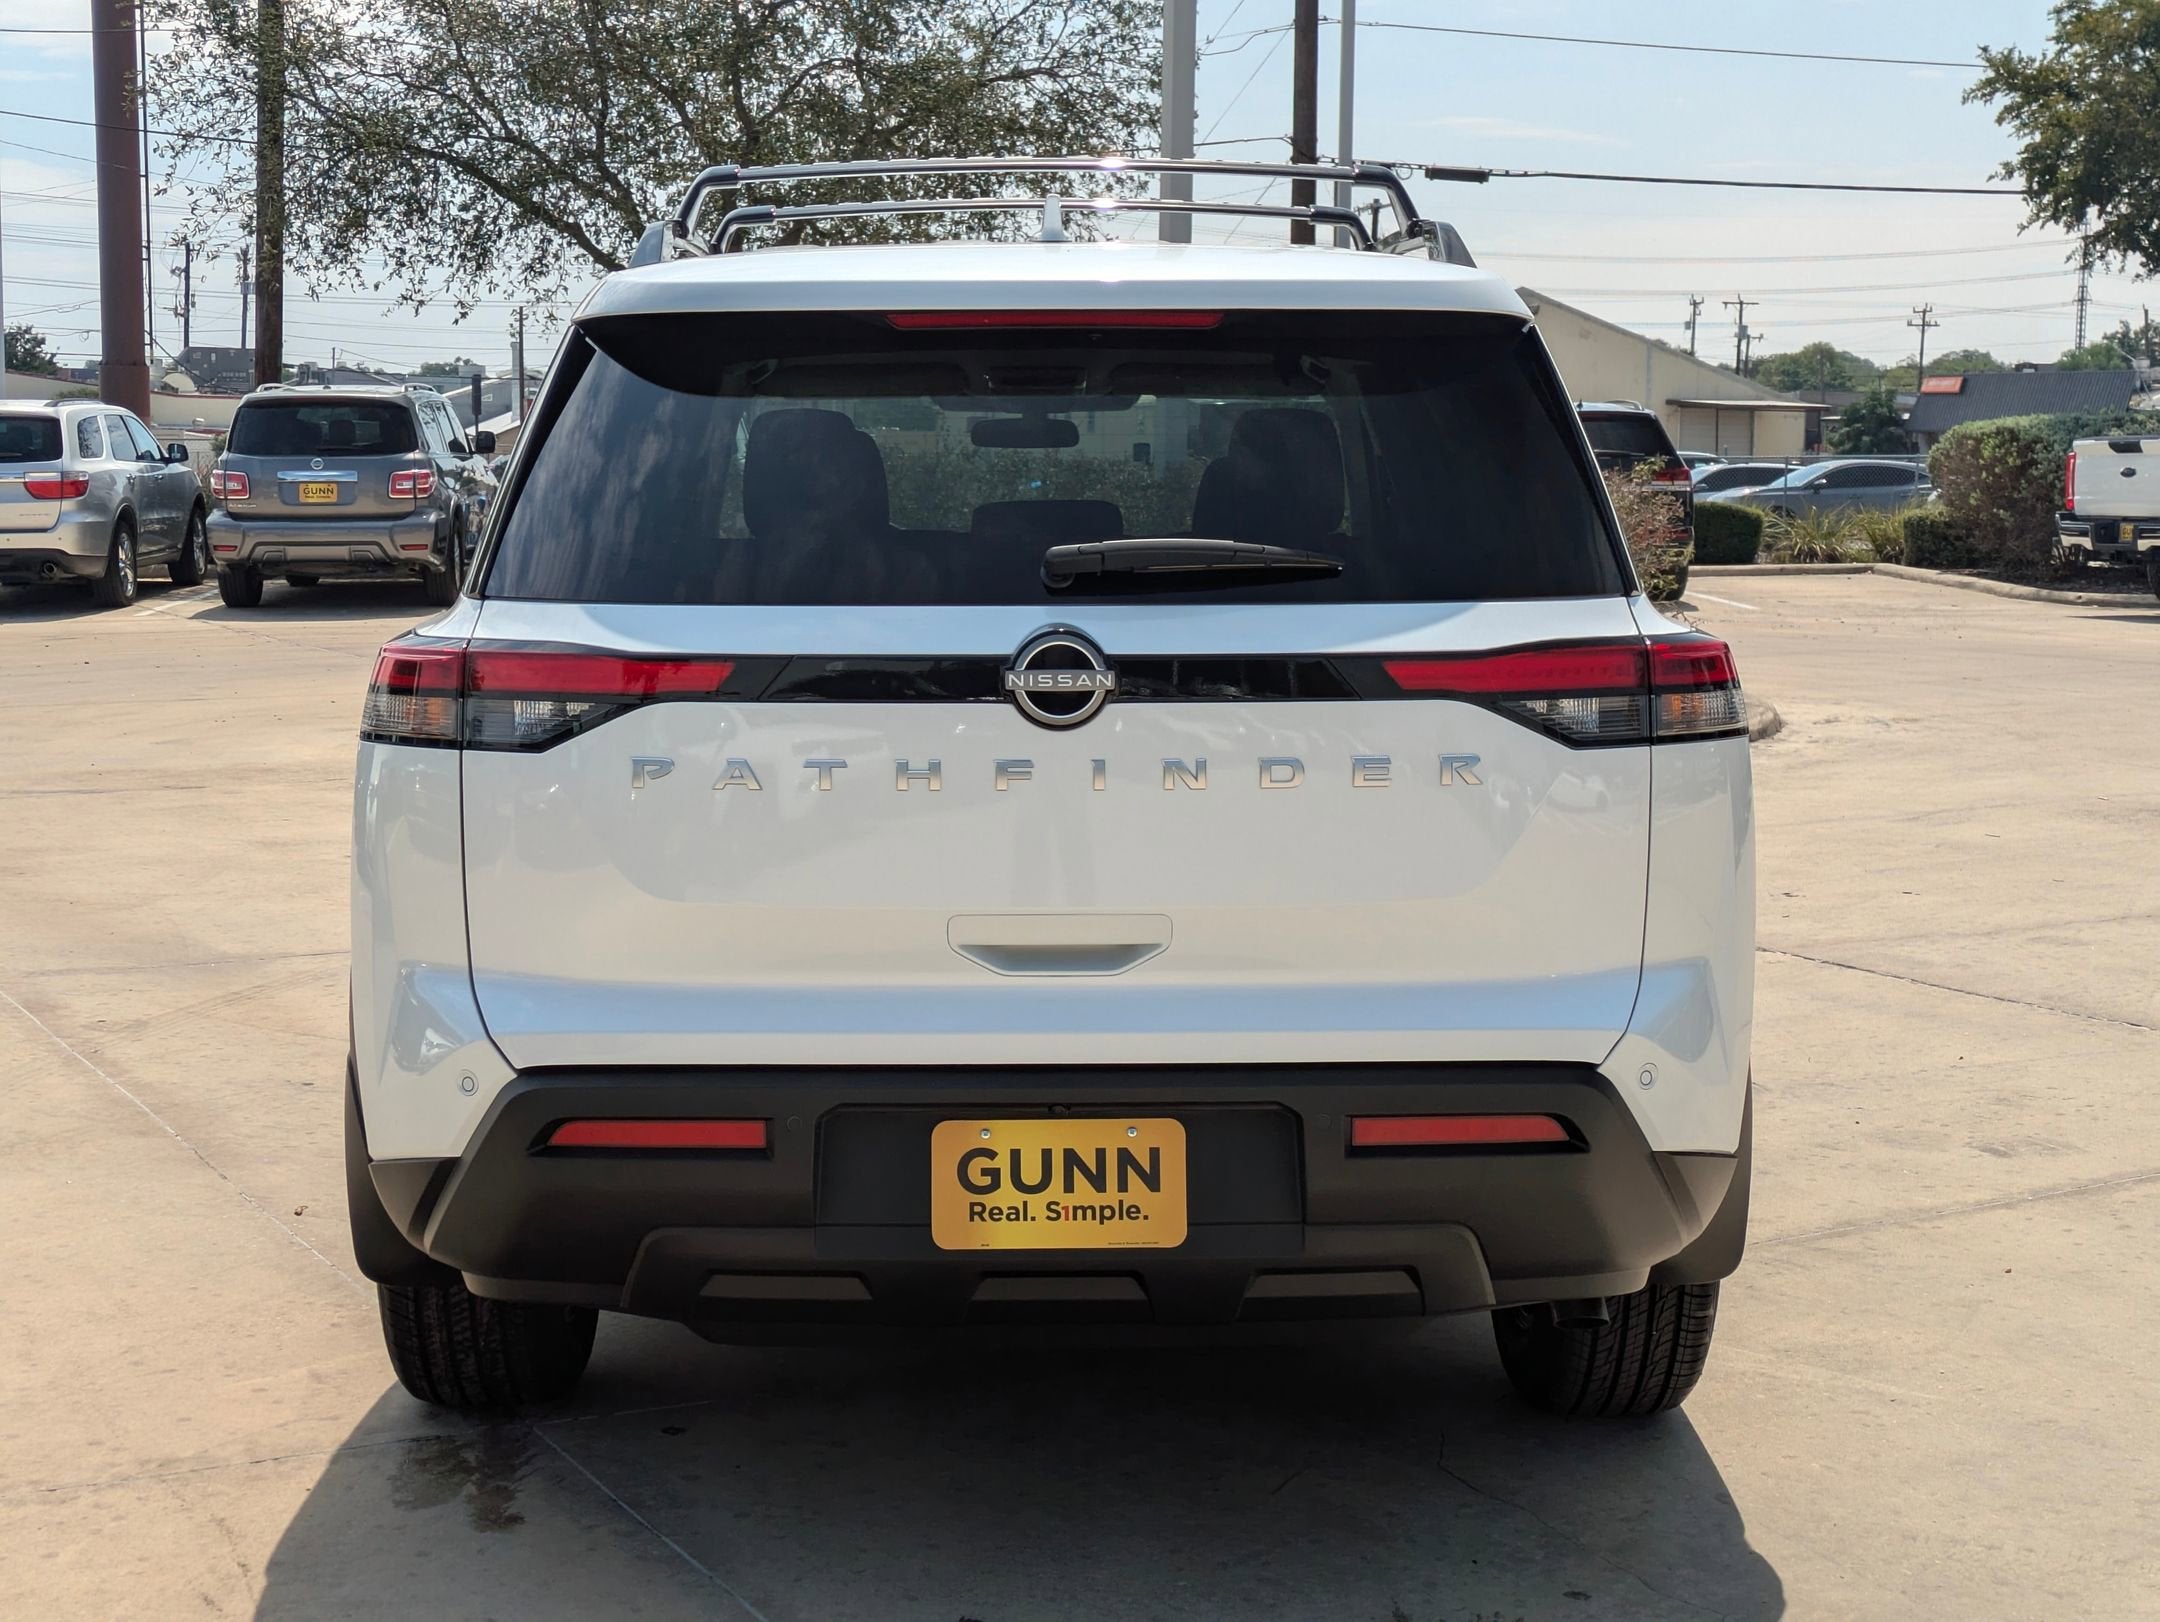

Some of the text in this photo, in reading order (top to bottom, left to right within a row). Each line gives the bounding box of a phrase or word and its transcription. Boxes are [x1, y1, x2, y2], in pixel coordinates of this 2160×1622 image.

[1008, 674, 1112, 687] NISSAN
[631, 753, 1484, 792] PATHFINDER
[957, 1147, 1161, 1195] GUNN
[969, 1201, 1036, 1222] Real.
